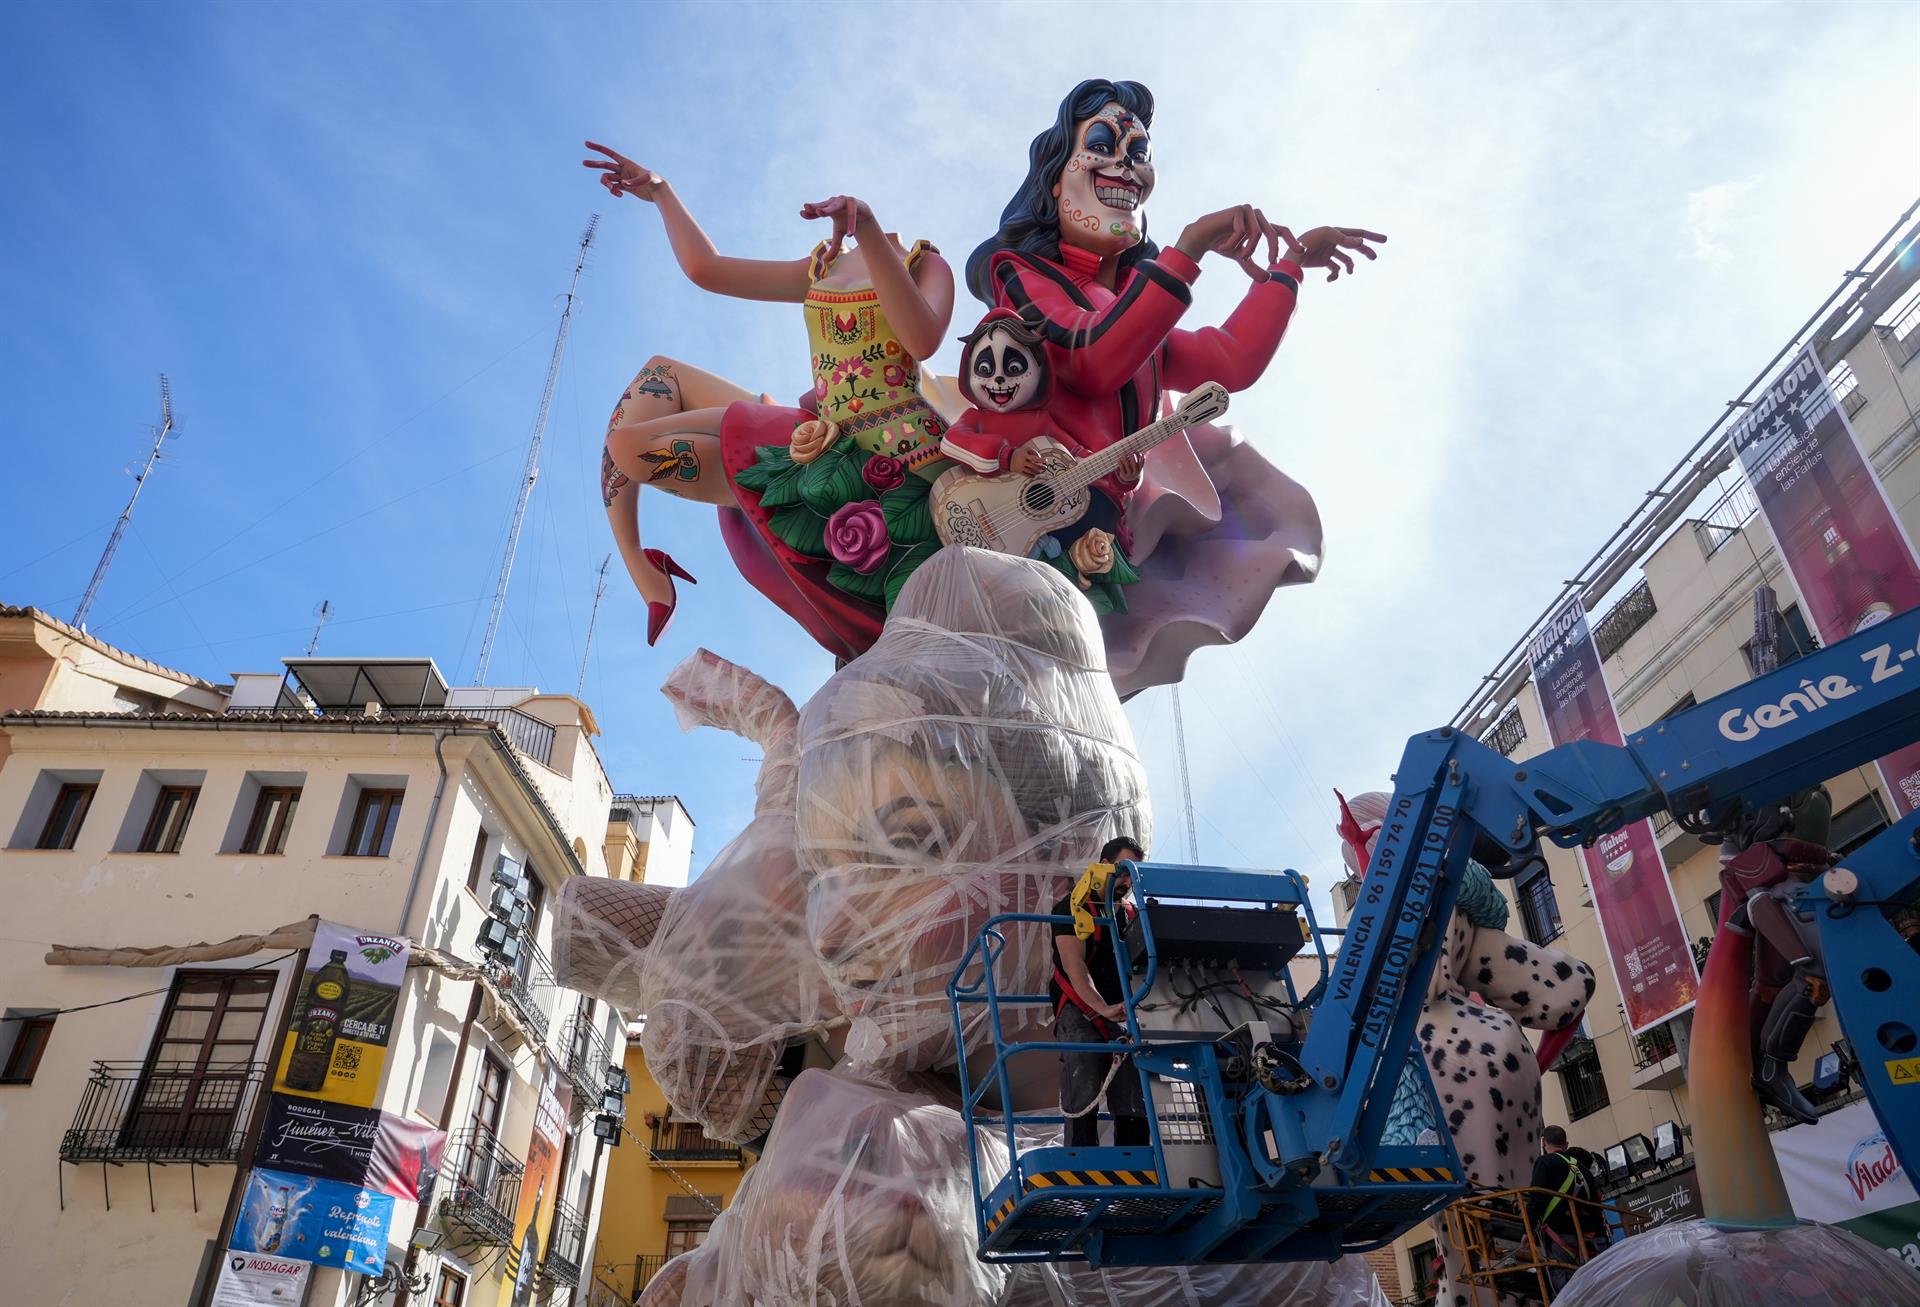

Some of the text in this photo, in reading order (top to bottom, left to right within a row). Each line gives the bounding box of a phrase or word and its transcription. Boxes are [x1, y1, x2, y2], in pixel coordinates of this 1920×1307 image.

[1775, 438, 1819, 481] enciende
[1780, 451, 1823, 493] las Fallas
[1527, 602, 1583, 664] Mahou
[1552, 677, 1562, 690] La
[1555, 670, 1584, 700] enciende
[1718, 630, 1920, 742] Genie Z-
[1600, 830, 1629, 855] Mahou
[1334, 800, 1412, 1000] VALENCIA 96 159 74 70
[1361, 804, 1457, 1049] CASTELLON 96 421 19 00
[360, 936, 401, 951] URZANTE
[344, 1018, 367, 1032] CERCA
[367, 1022, 378, 1034] DE
[287, 1104, 321, 1115] BODEGAS
[355, 1150, 373, 1159] HNO
[1844, 1144, 1901, 1202] Vilad
[324, 1227, 377, 1248] valenciana
[247, 1259, 301, 1276] INSDAGAR
